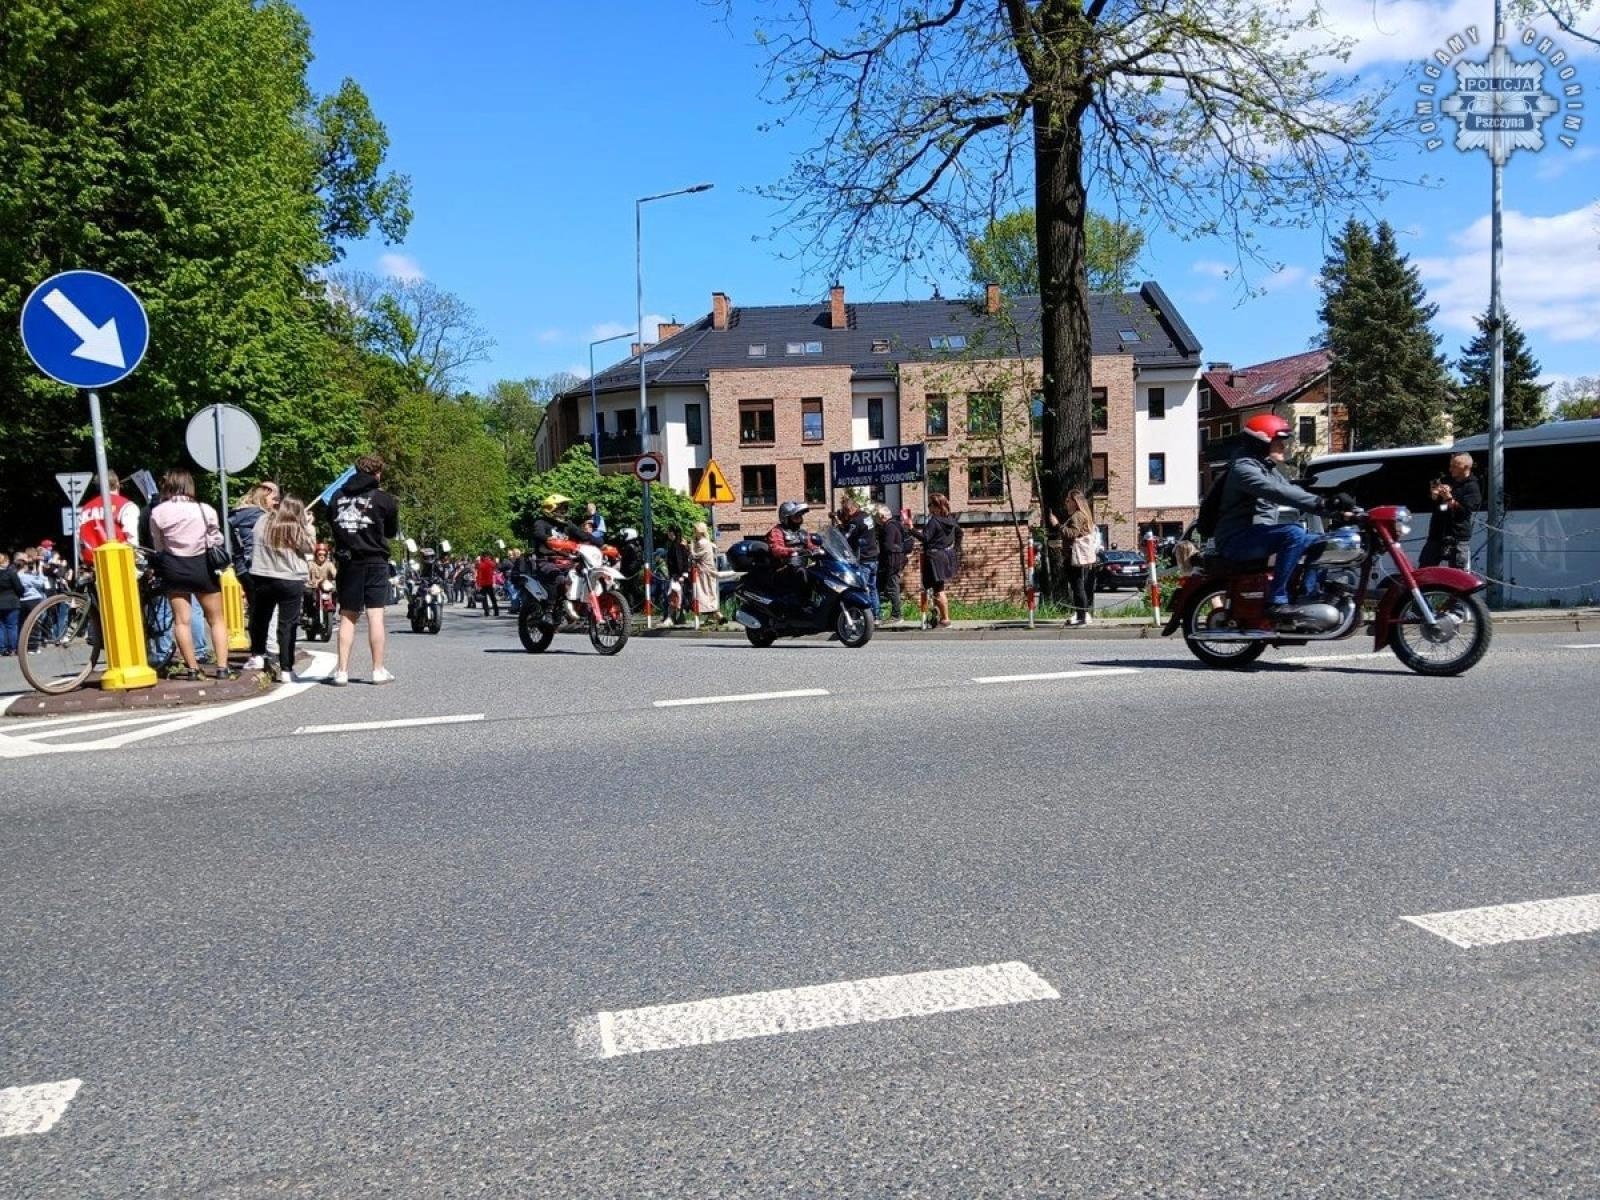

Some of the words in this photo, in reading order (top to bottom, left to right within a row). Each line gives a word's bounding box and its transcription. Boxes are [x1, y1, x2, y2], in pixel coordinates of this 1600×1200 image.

[843, 447, 910, 466] PARKING
[857, 463, 894, 473] MIEJSKI
[837, 475, 873, 486] AUTOBUSY
[880, 471, 917, 483] OSOBOWE
